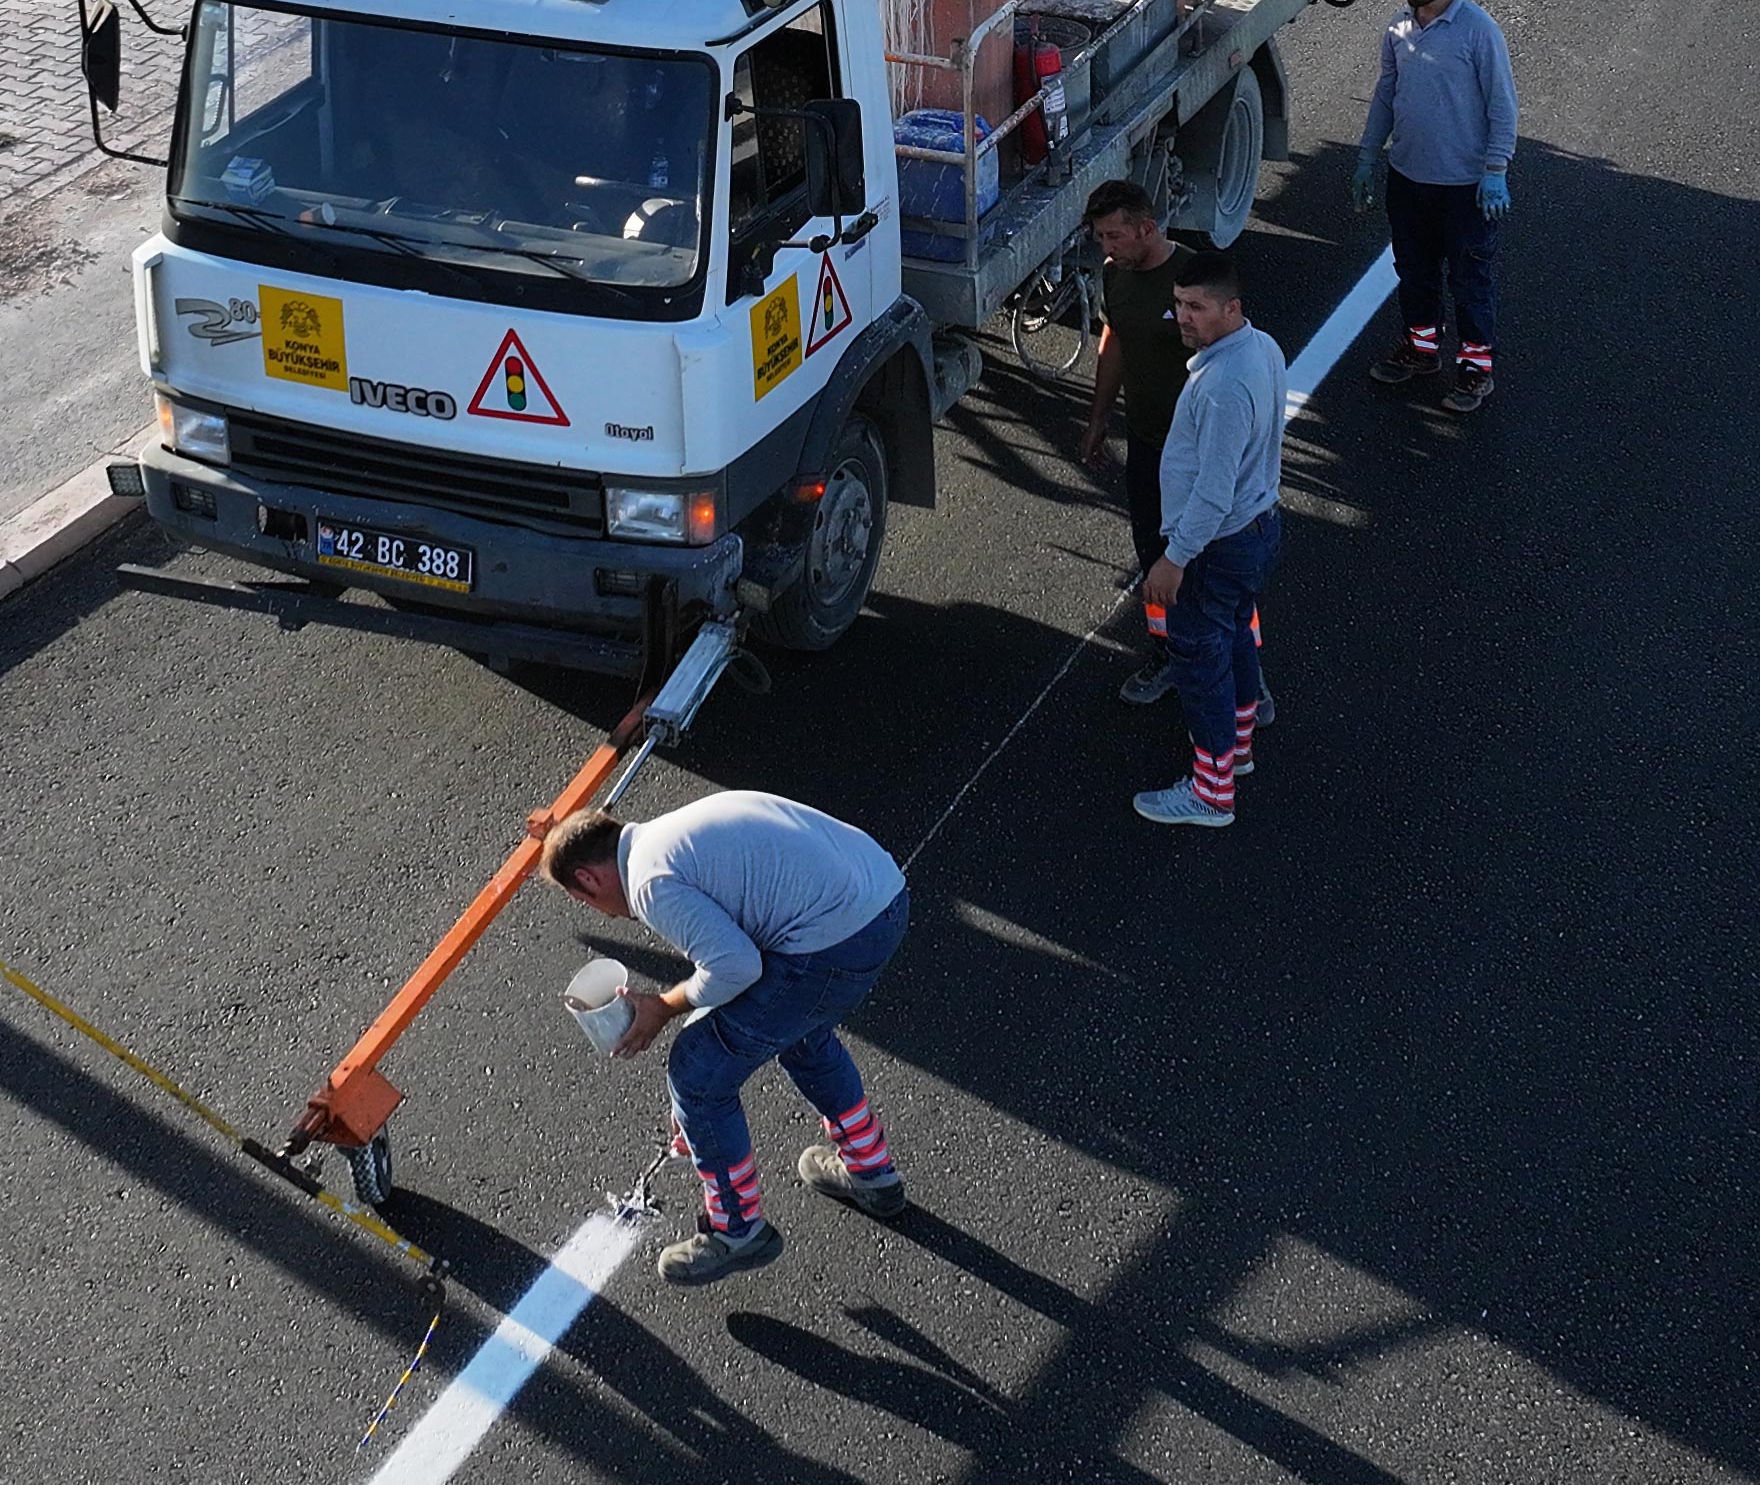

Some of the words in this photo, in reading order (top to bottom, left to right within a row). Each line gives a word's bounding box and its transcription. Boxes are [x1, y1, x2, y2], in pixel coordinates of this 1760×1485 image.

[285, 339, 320, 355] KONYA
[349, 376, 458, 421] IVECO
[336, 529, 365, 559] 42
[377, 536, 405, 566] BC
[417, 545, 460, 578] 388
